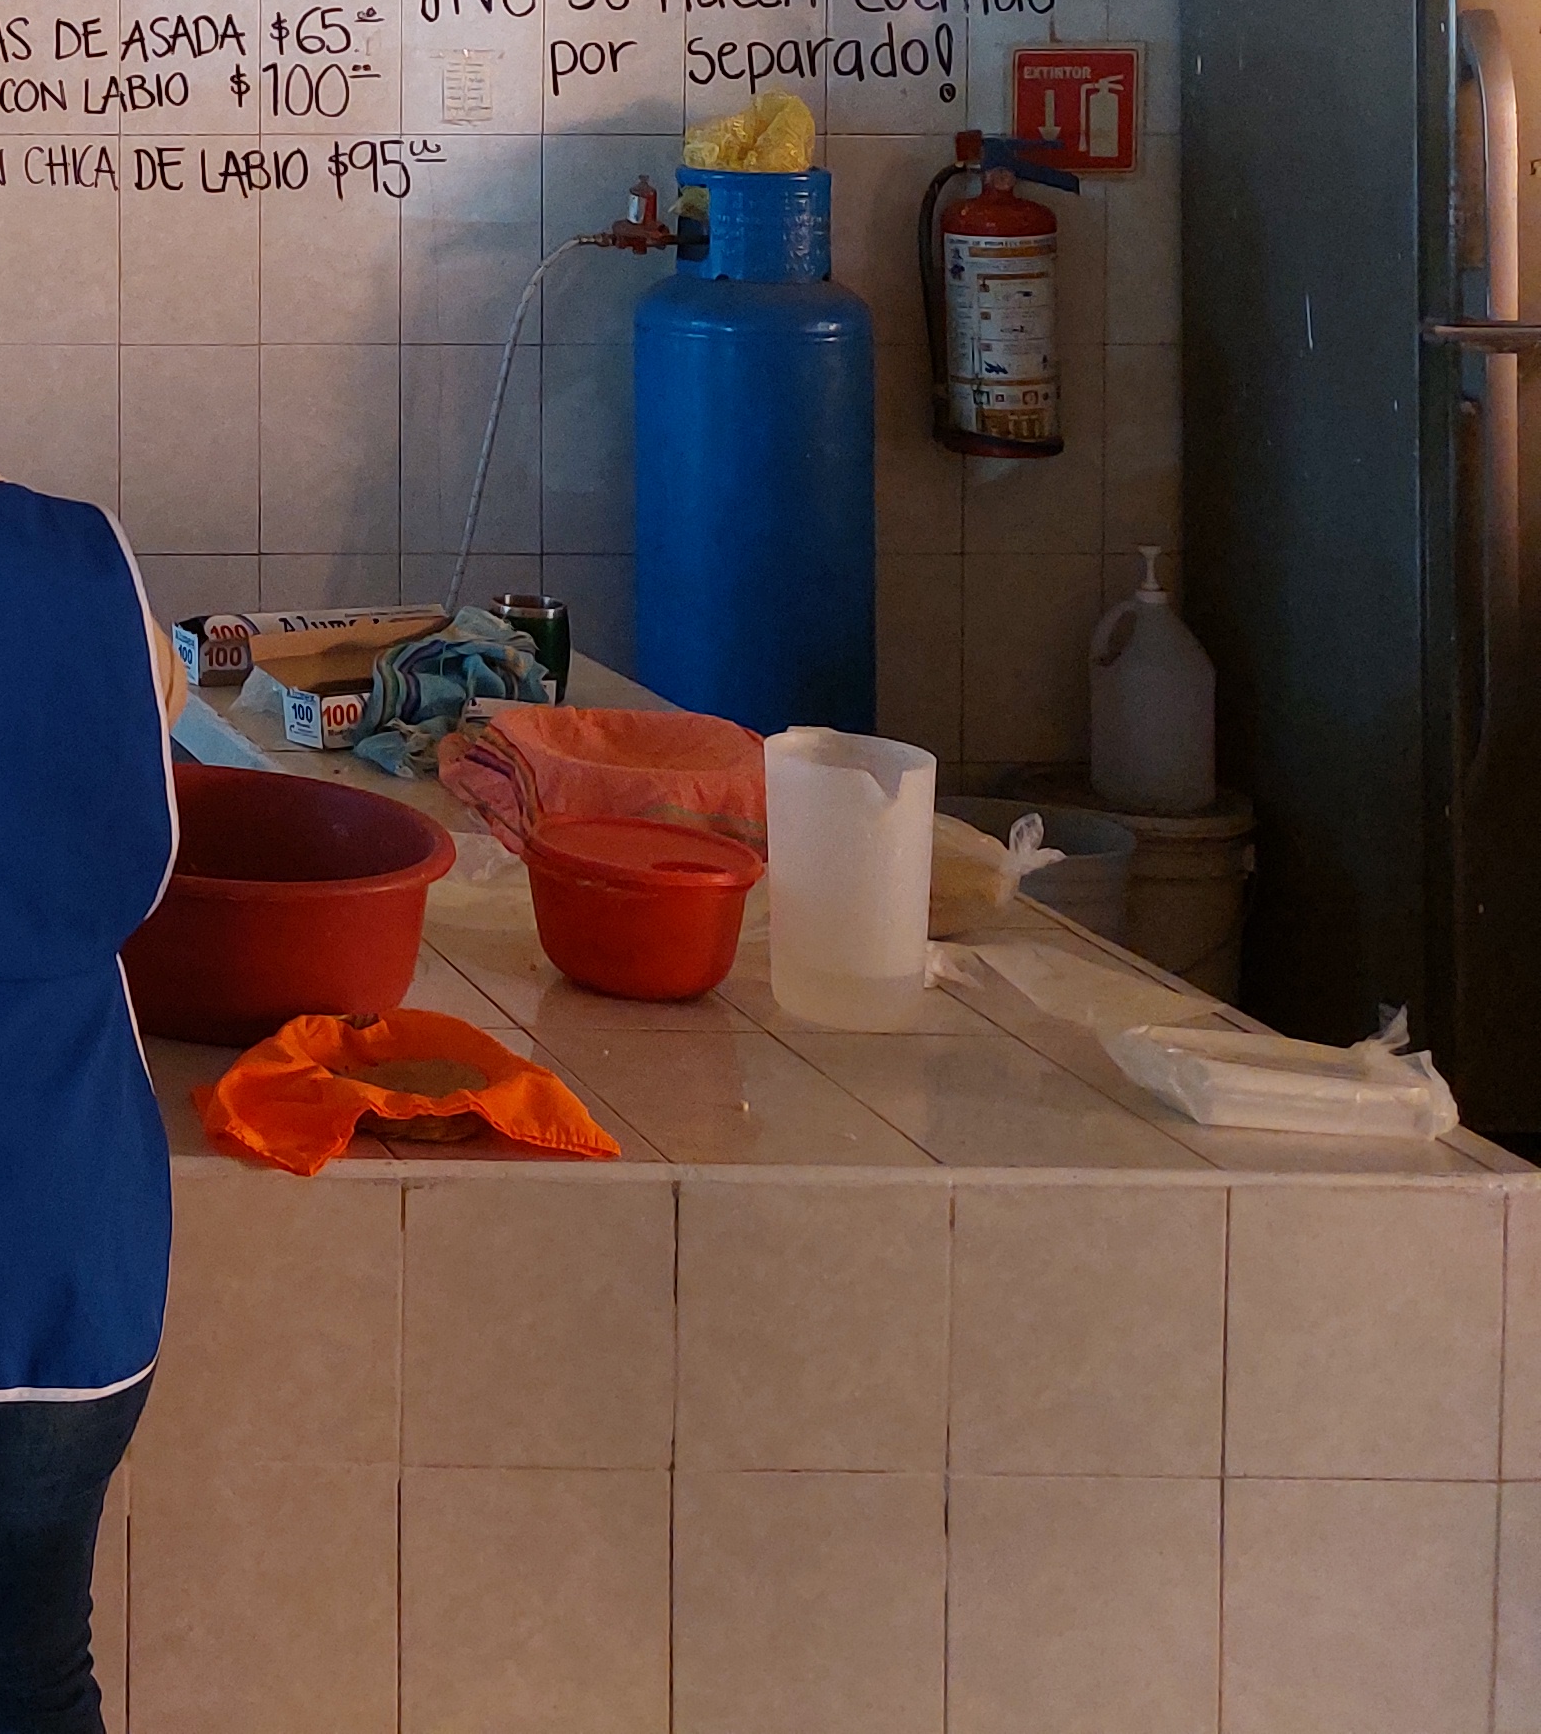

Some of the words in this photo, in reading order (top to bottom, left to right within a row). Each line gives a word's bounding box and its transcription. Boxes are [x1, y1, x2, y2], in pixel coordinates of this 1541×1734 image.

[55, 18, 107, 60] DE
[121, 14, 246, 62] ASADA
[551, 34, 637, 96] por
[687, 19, 956, 107] separado!
[1023, 66, 1091, 80] EXTINTOR
[0, 78, 67, 113] CON
[84, 72, 188, 114] LABIO
[25, 145, 120, 194] CHICA
[134, 147, 185, 190] DE
[201, 148, 308, 198] LABIO
[204, 646, 242, 667] 100
[291, 702, 313, 724] 100
[322, 703, 358, 727] 100
